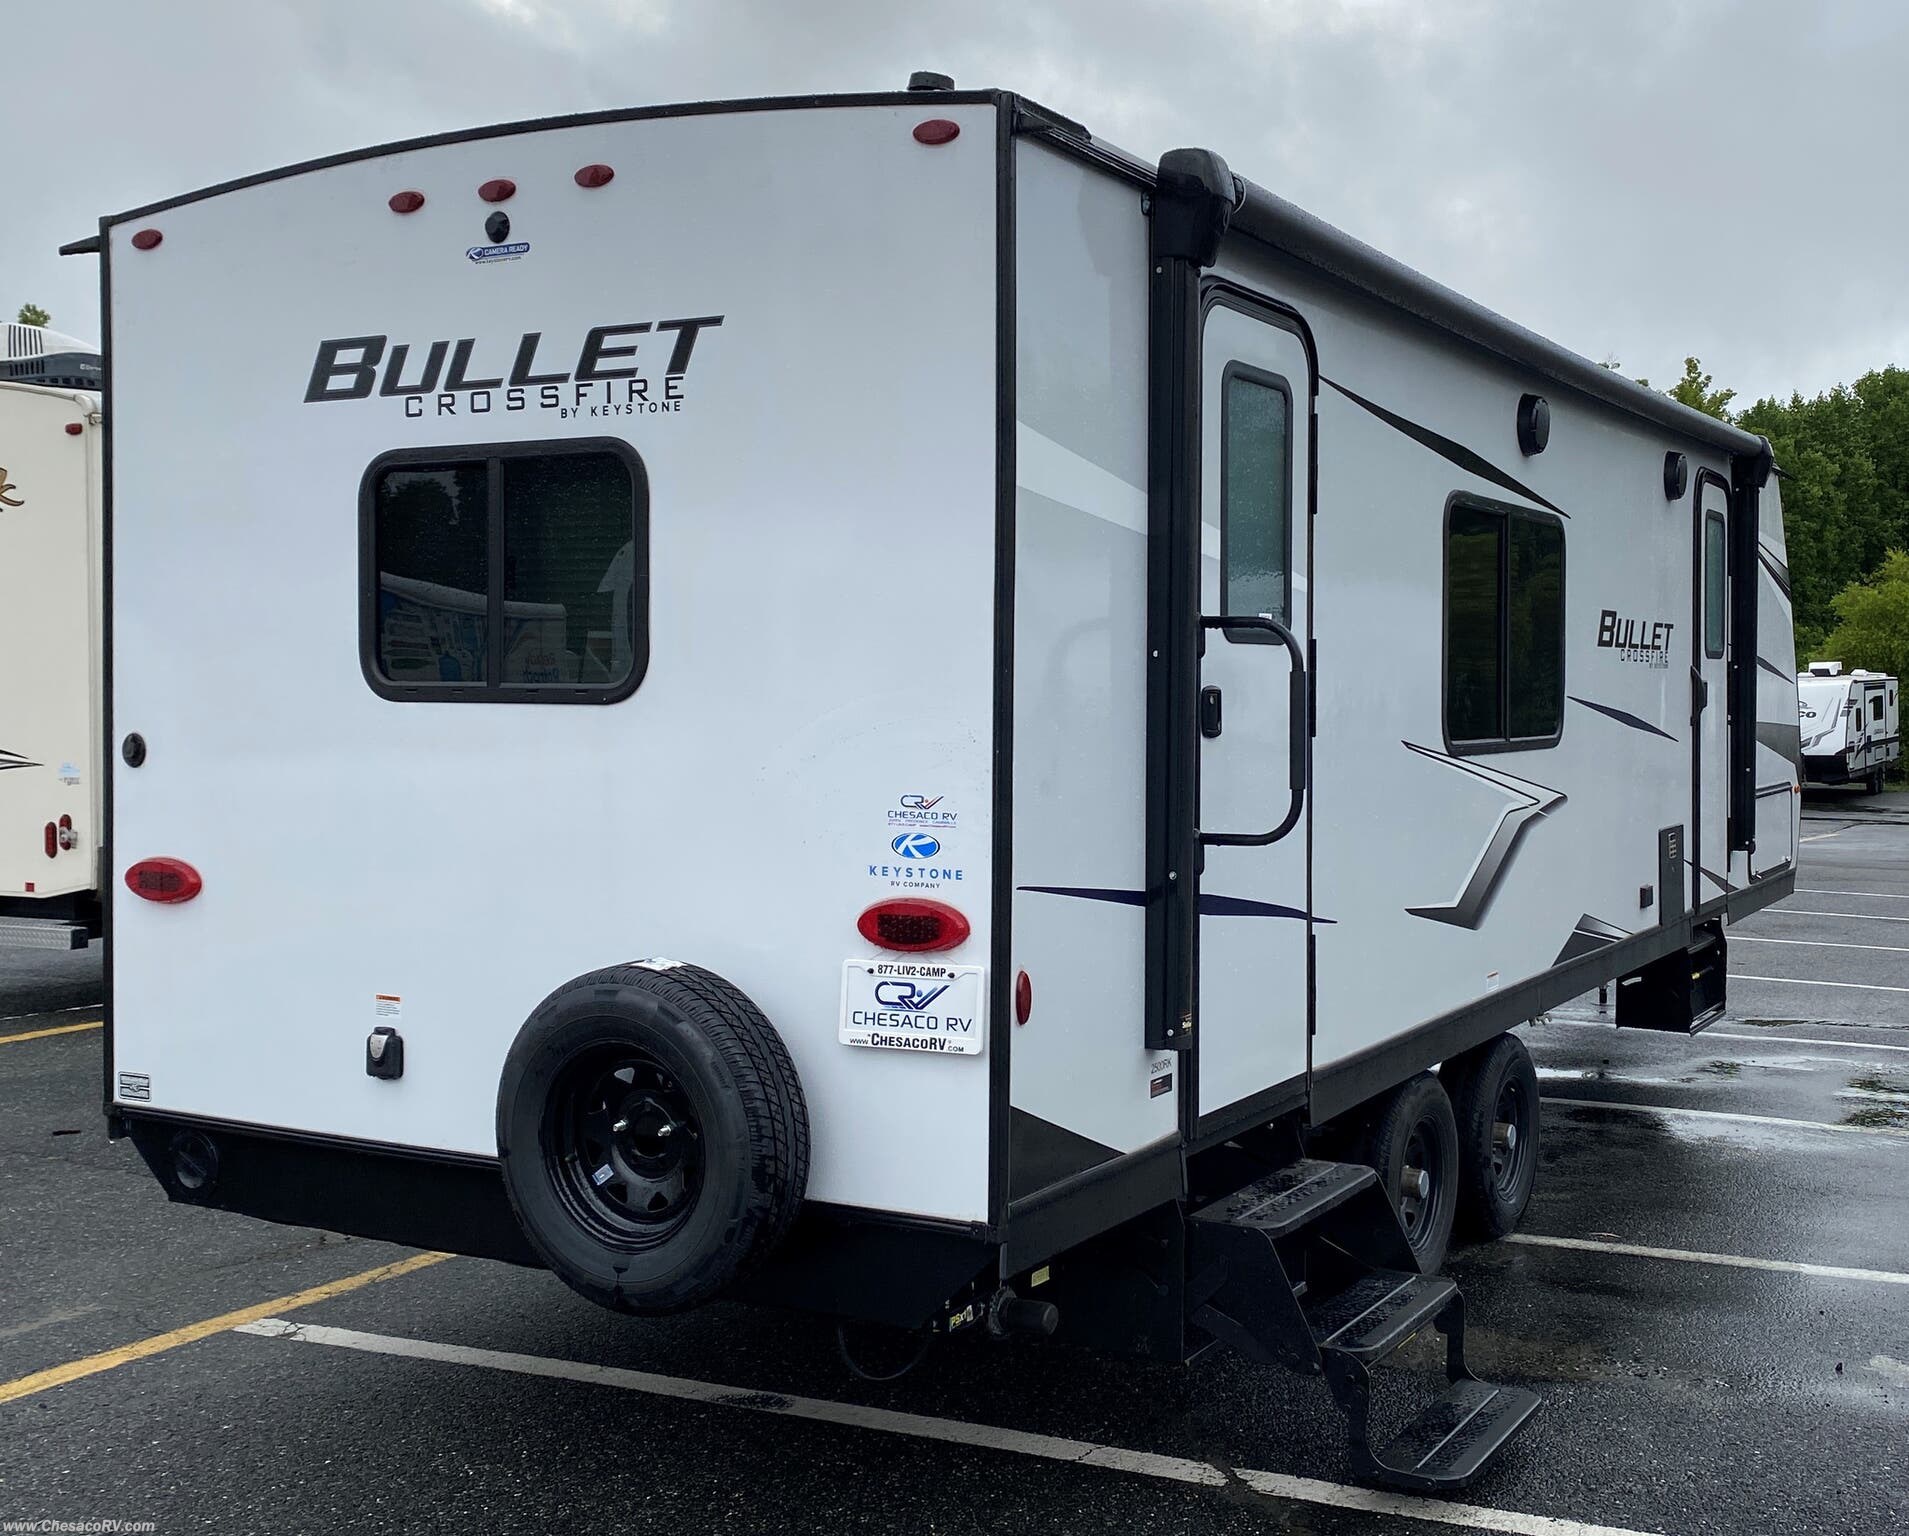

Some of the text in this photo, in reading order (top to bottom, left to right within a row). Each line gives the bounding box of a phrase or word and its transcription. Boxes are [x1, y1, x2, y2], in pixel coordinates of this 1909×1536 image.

[484, 243, 528, 256] CAMERA READY
[303, 315, 725, 403] BULLET
[405, 375, 684, 418] CROSSFIRE
[560, 400, 681, 419] BY KEYSTONE
[1597, 609, 1674, 651] BULLET
[1620, 648, 1669, 663] CROSSFIRE
[887, 810, 958, 821] CHESACO RV
[869, 865, 963, 880] KEYSTONE
[903, 881, 941, 889] COMPANY
[877, 964, 947, 978] 877-LIV2-CAMP
[852, 1011, 972, 1032] CHESACO RV
